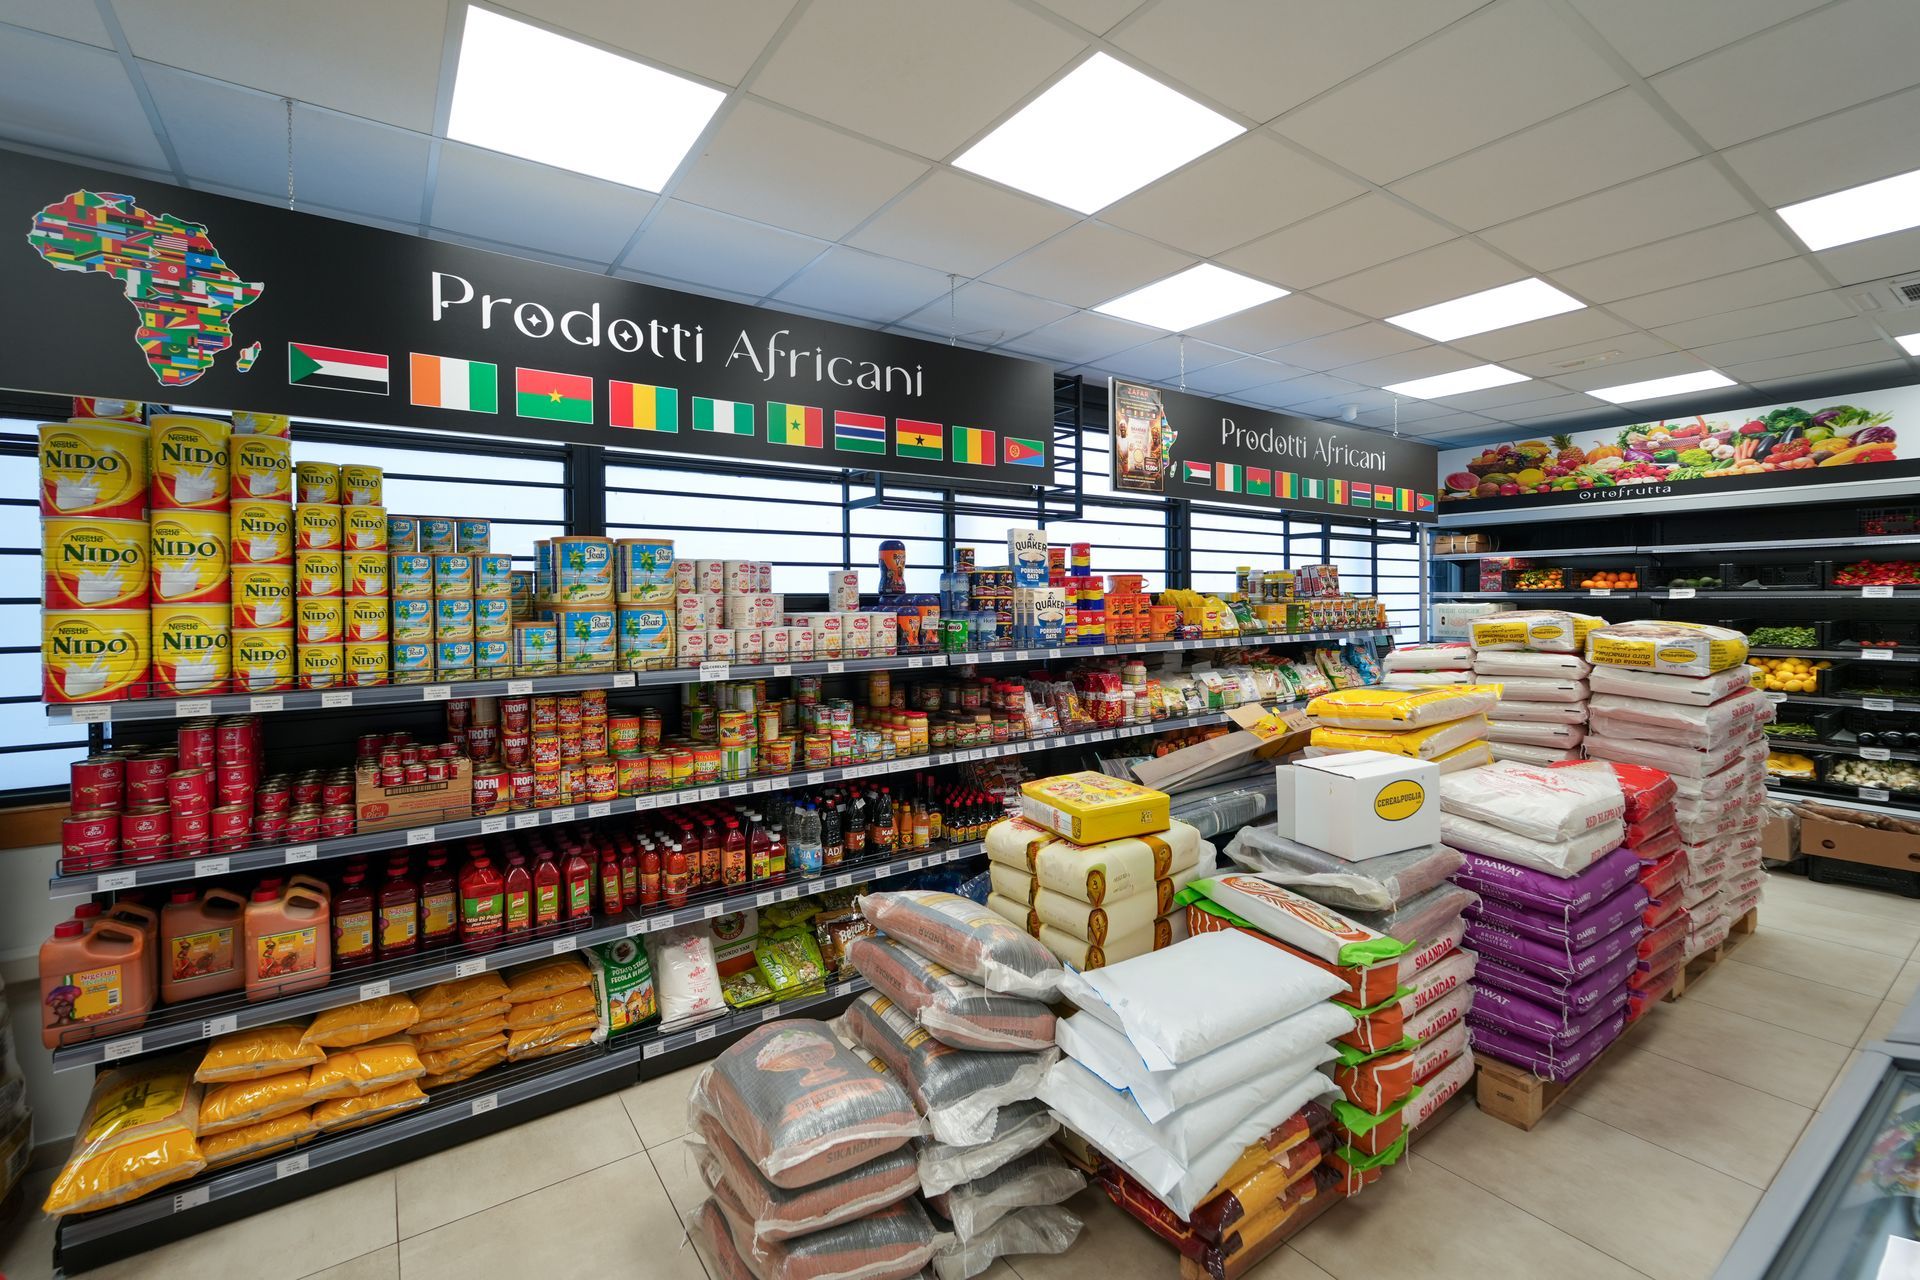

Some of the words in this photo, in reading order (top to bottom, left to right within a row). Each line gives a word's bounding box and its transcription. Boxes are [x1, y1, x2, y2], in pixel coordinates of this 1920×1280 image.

[432, 271, 704, 363] Prodotti
[725, 329, 923, 397] Africani
[1222, 418, 1306, 458] Prodotti
[1313, 436, 1386, 471] Africani
[46, 451, 119, 471] NIDO
[161, 443, 227, 466] NIDO
[240, 454, 287, 469] NIDO
[301, 474, 333, 485] NIDO
[347, 477, 378, 488] NIDO
[1579, 484, 1672, 500] Ortofrutta
[240, 519, 287, 532] NIDO
[303, 517, 337, 527] NIDO
[350, 518, 382, 528] NIDO
[63, 544, 138, 563] NIDO
[153, 538, 216, 557] NIDO
[585, 546, 607, 560] Peak
[1015, 541, 1047, 552] QUAKER
[656, 548, 673, 561] Peak
[305, 564, 338, 574] NIDO
[358, 564, 386, 574] NIDO
[245, 584, 290, 597] NIDO
[1035, 600, 1065, 611] QUAKER
[302, 611, 335, 620] NIDO
[353, 610, 385, 619] NIDO
[640, 614, 662, 626] Peak
[591, 616, 611, 629] Peak
[53, 637, 127, 655] NIDO
[162, 632, 228, 650] NIDO
[240, 649, 287, 661] NIDO
[305, 658, 338, 667] NIDO
[351, 656, 384, 665] NIDO
[1727, 676, 1745, 690] SIKANDAR
[1731, 703, 1755, 720] SIKANDAR
[1377, 791, 1422, 808] CEREALPUGLIA
[366, 811, 385, 820] Rica
[1586, 815, 1598, 830] RED
[1598, 805, 1626, 827] ELEPHANT
[1474, 858, 1525, 878] DAAWAT
[1624, 862, 1641, 877] DAAWAT
[1572, 892, 1592, 906] DAAWAT
[1633, 897, 1650, 911] DAAWAT
[917, 925, 956, 953] SIKANDAR
[1480, 931, 1509, 943] BROKEN
[1576, 926, 1597, 941] DAAWAT
[717, 947, 739, 959] POUNDO
[740, 944, 750, 953] YAM
[1415, 937, 1453, 970] SIKANDAR
[612, 965, 633, 976] POTATO
[1577, 955, 1596, 971] DAAWAT
[80, 968, 117, 981] Nigerian
[610, 972, 632, 984] FECOLA
[1414, 975, 1457, 1009] SIKANDAR
[1473, 983, 1511, 1005] AAWAT
[1418, 1007, 1458, 1041] SIKANDAR
[1557, 1025, 1581, 1040] DAAWAT
[1413, 1049, 1449, 1081] IKANDAR
[1561, 1053, 1581, 1068] DAAWAT
[1420, 1081, 1459, 1120] SIKANDAR
[826, 1137, 881, 1164] SIKANDAR
